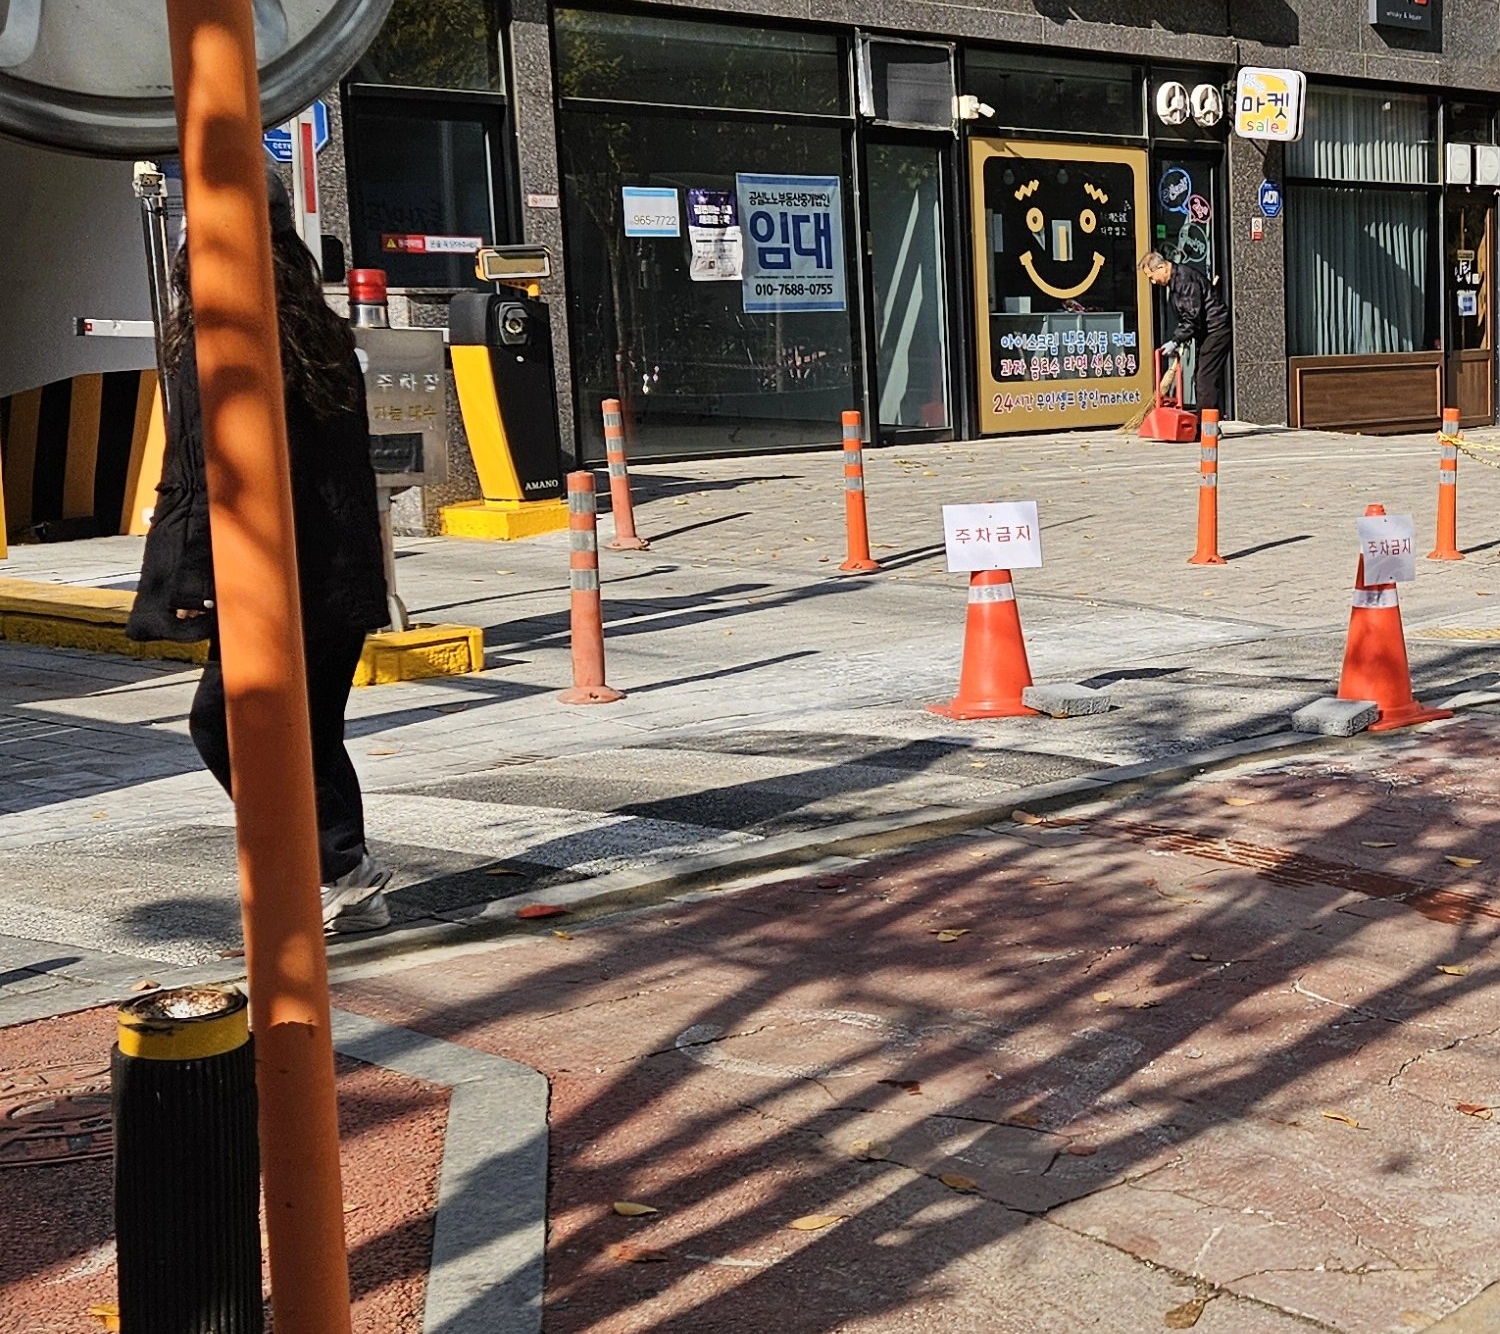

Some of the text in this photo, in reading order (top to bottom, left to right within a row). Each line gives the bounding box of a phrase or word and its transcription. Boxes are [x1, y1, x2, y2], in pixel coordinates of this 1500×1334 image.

[1241, 92, 1290, 120] 마켓
[1246, 117, 1280, 134] sale
[1262, 190, 1279, 204] ADT
[750, 210, 834, 270] 임대
[755, 283, 833, 296] 010-7688-0755
[1001, 333, 1060, 355] 아이스크림
[1062, 331, 1108, 355] 냉동식품
[1001, 353, 1136, 380] 과자 음료수 라면 생수 안주
[993, 394, 1034, 415] 24시간
[1036, 392, 1076, 411] 무인셀프
[955, 525, 1031, 544] 주차금지
[1367, 538, 1411, 557] 주차금지
